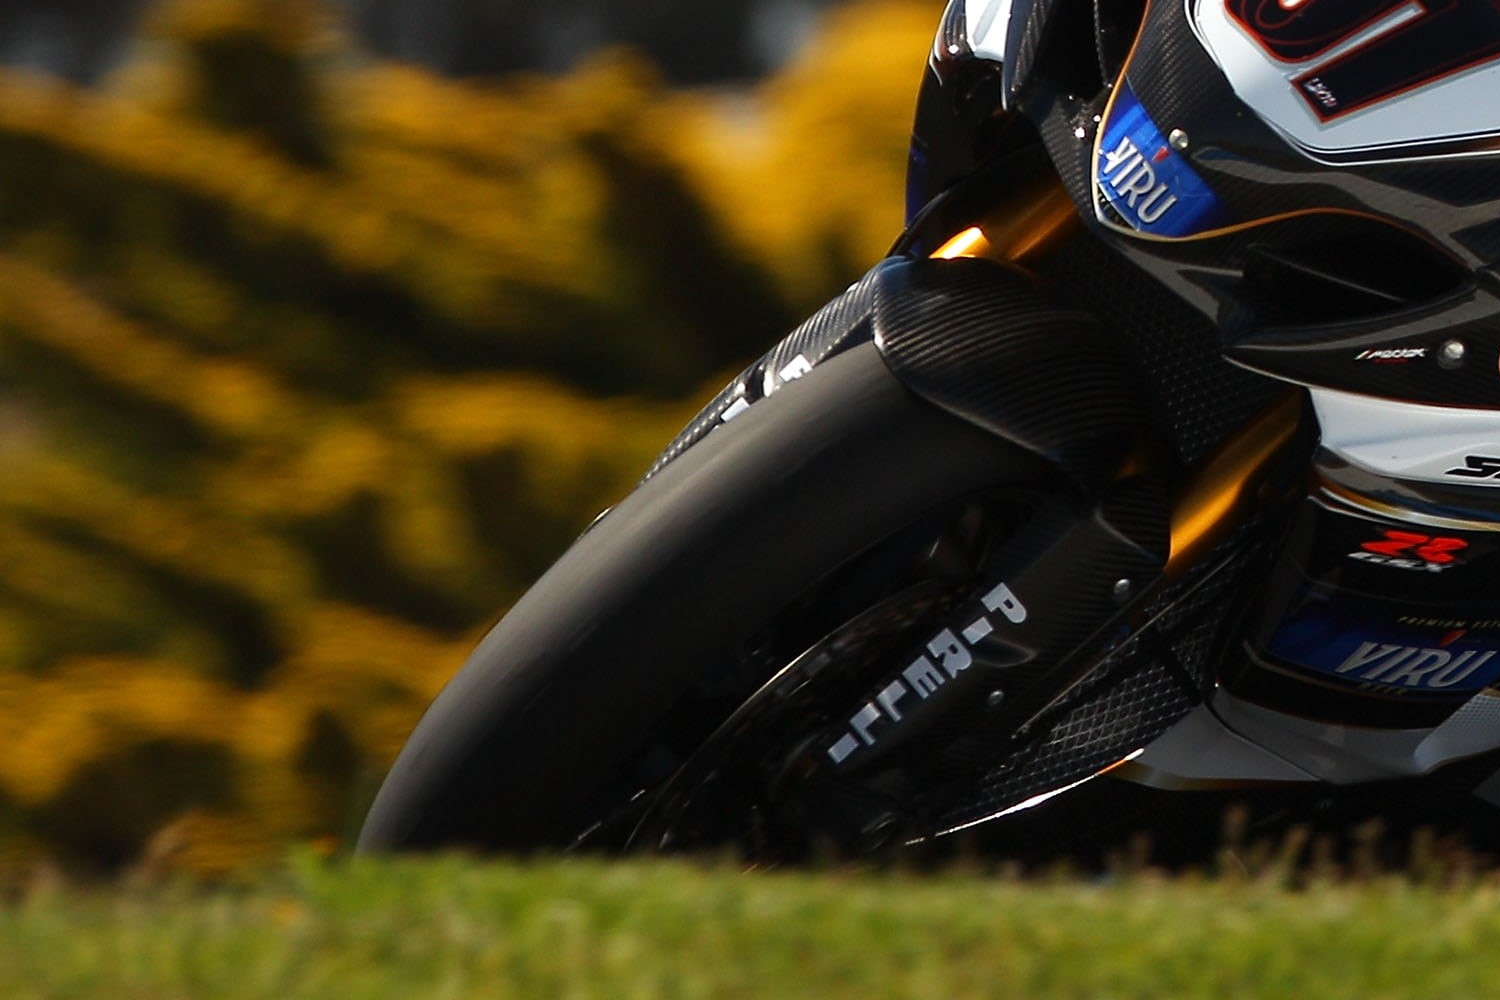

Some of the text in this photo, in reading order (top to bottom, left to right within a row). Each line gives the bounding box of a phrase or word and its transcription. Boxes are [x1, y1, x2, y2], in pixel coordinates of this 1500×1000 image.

[1103, 135, 1178, 223] VIRU
[827, 582, 1027, 764] PIRELLI
[1335, 641, 1498, 688] VIRU
